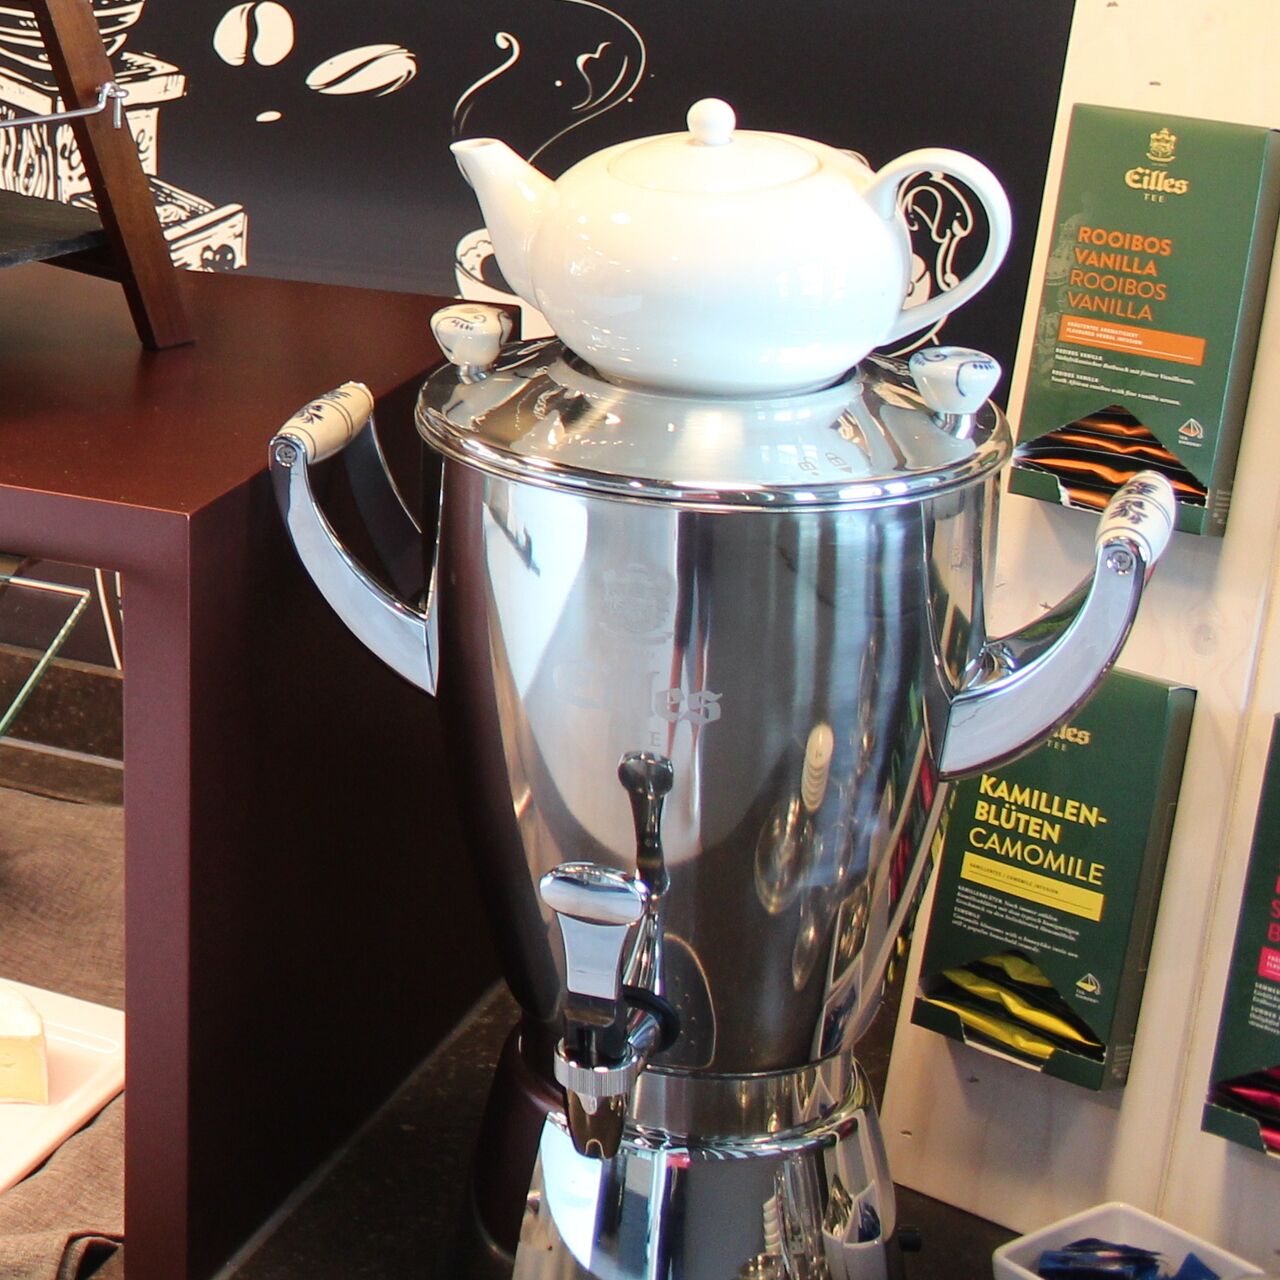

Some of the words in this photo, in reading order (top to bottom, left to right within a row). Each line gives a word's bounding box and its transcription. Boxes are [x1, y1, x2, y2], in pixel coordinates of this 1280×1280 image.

[1124, 166, 1190, 194] Eilles
[1144, 193, 1168, 203] TEE
[1078, 226, 1173, 256] ROOIBOS
[1074, 247, 1158, 277] VANILLA
[1070, 269, 1168, 301] ROOIBOS
[1067, 290, 1153, 322] VANILLA
[1047, 738, 1068, 752] TEE
[979, 773, 1108, 828] KAMILLEN-
[974, 799, 1062, 845] BLÜTEN
[968, 826, 1105, 886] CAMOMILE
